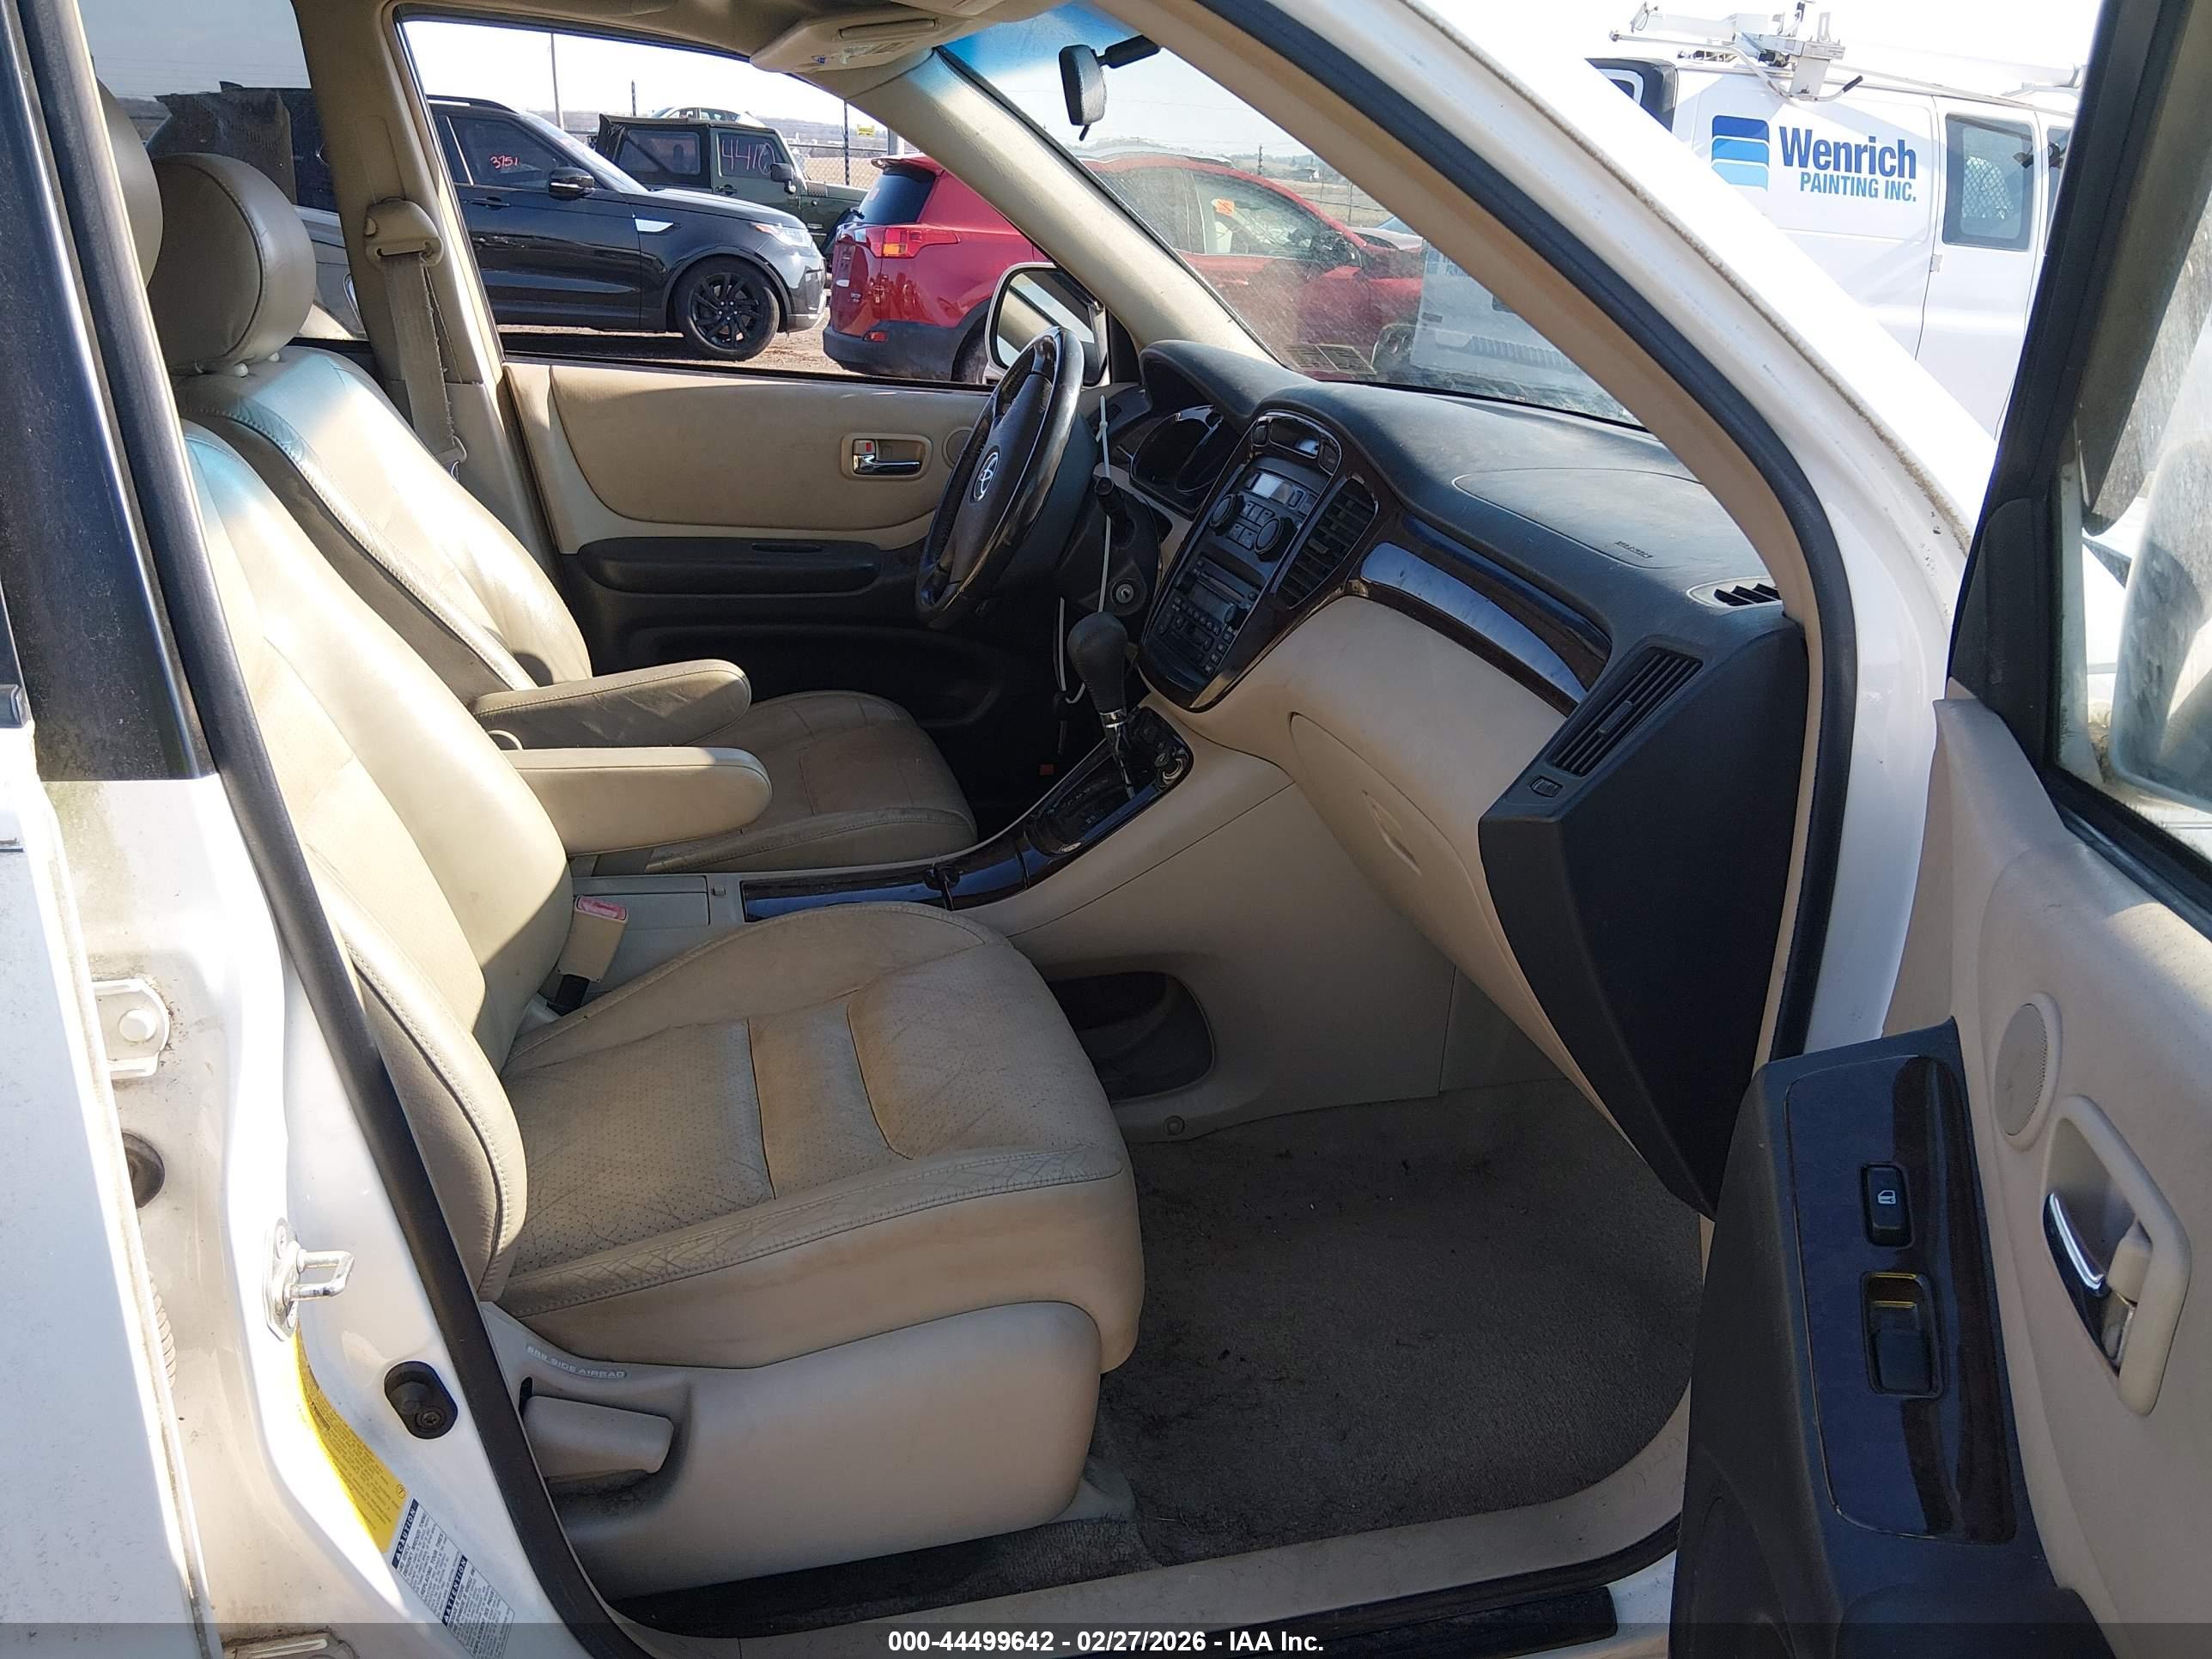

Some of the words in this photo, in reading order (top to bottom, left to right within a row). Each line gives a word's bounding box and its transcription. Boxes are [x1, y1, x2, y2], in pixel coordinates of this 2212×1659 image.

[489, 155, 519, 169] 3751
[1779, 126, 1916, 179] Wenrich
[1800, 172, 1878, 198] PAINTING
[1885, 179, 1917, 202] INC.
[398, 1509, 416, 1553] CAUTION
[445, 1559, 467, 1615] ATTENTION
